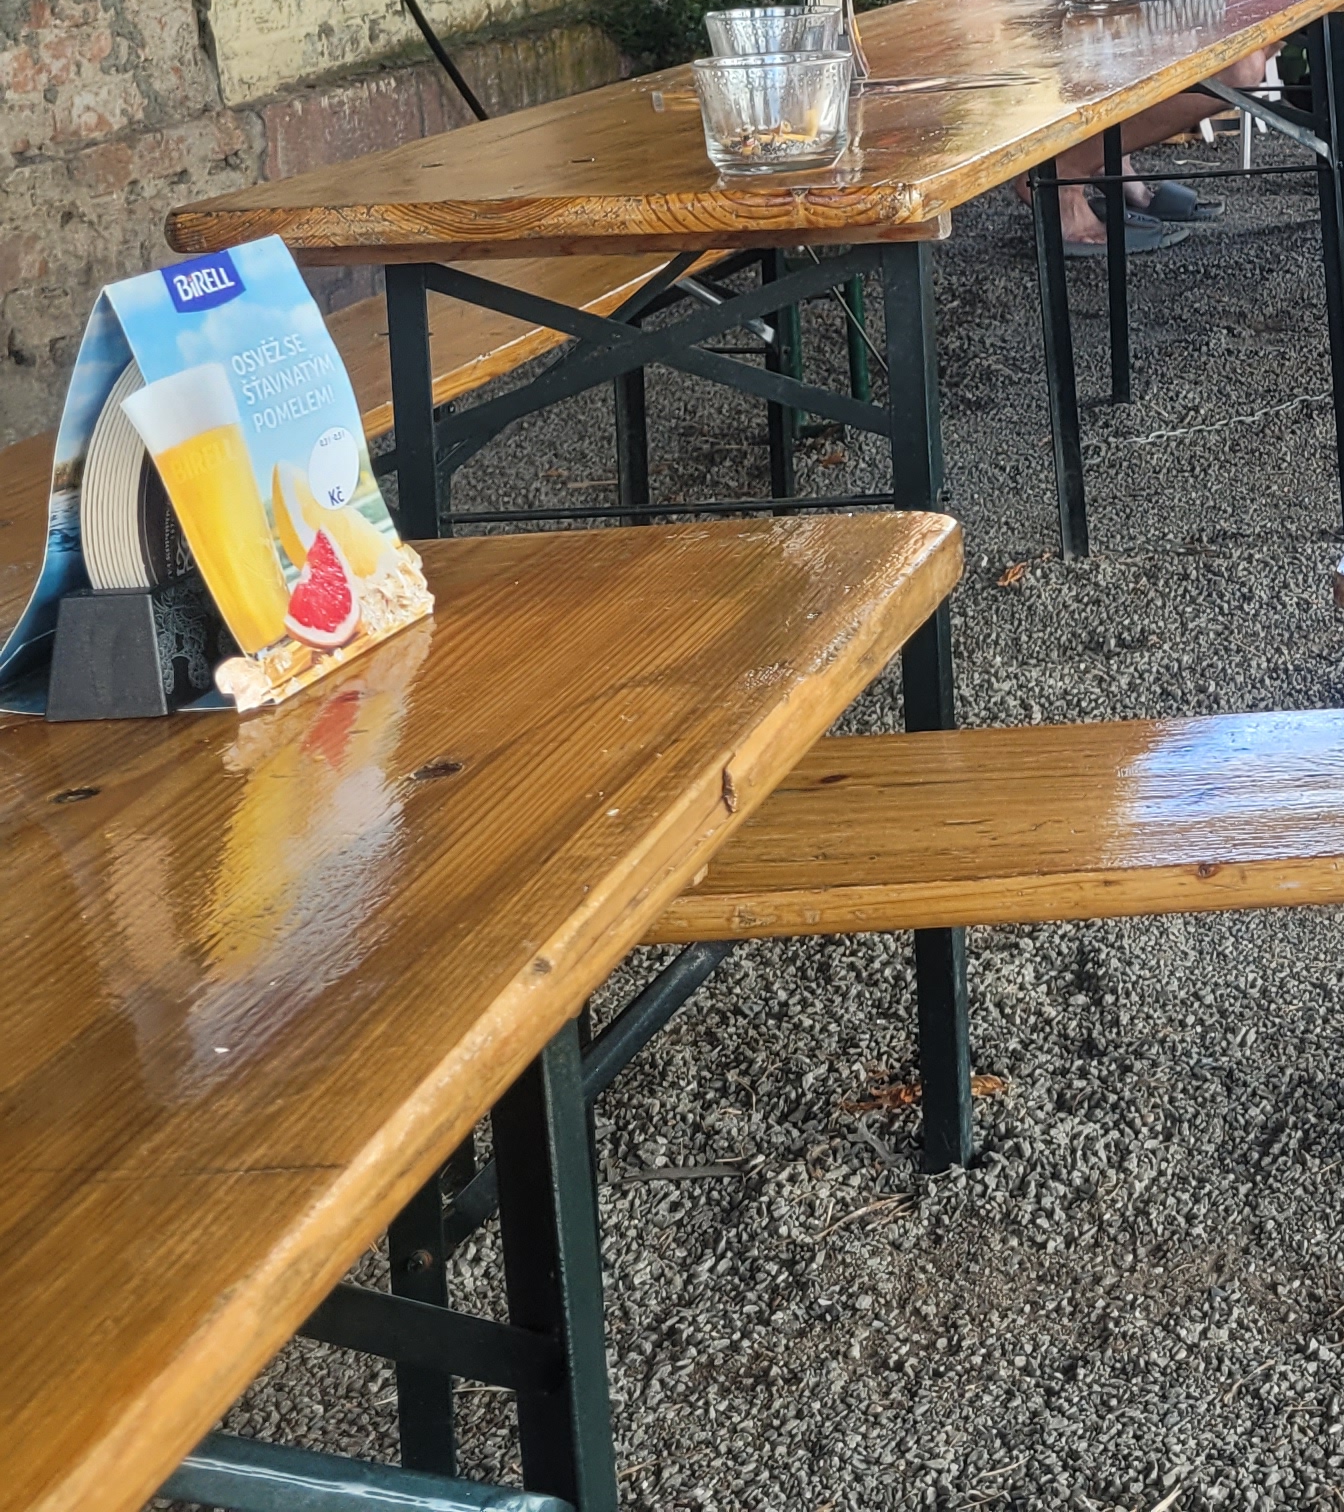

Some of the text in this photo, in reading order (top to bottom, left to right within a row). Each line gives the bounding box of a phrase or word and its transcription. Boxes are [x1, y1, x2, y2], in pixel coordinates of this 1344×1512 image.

[231, 333, 307, 376] OSVĚŽ SE
[241, 353, 336, 406] ŠŤAVNATÝM
[253, 384, 336, 433] POMELEM!
[328, 486, 345, 506] Kč
